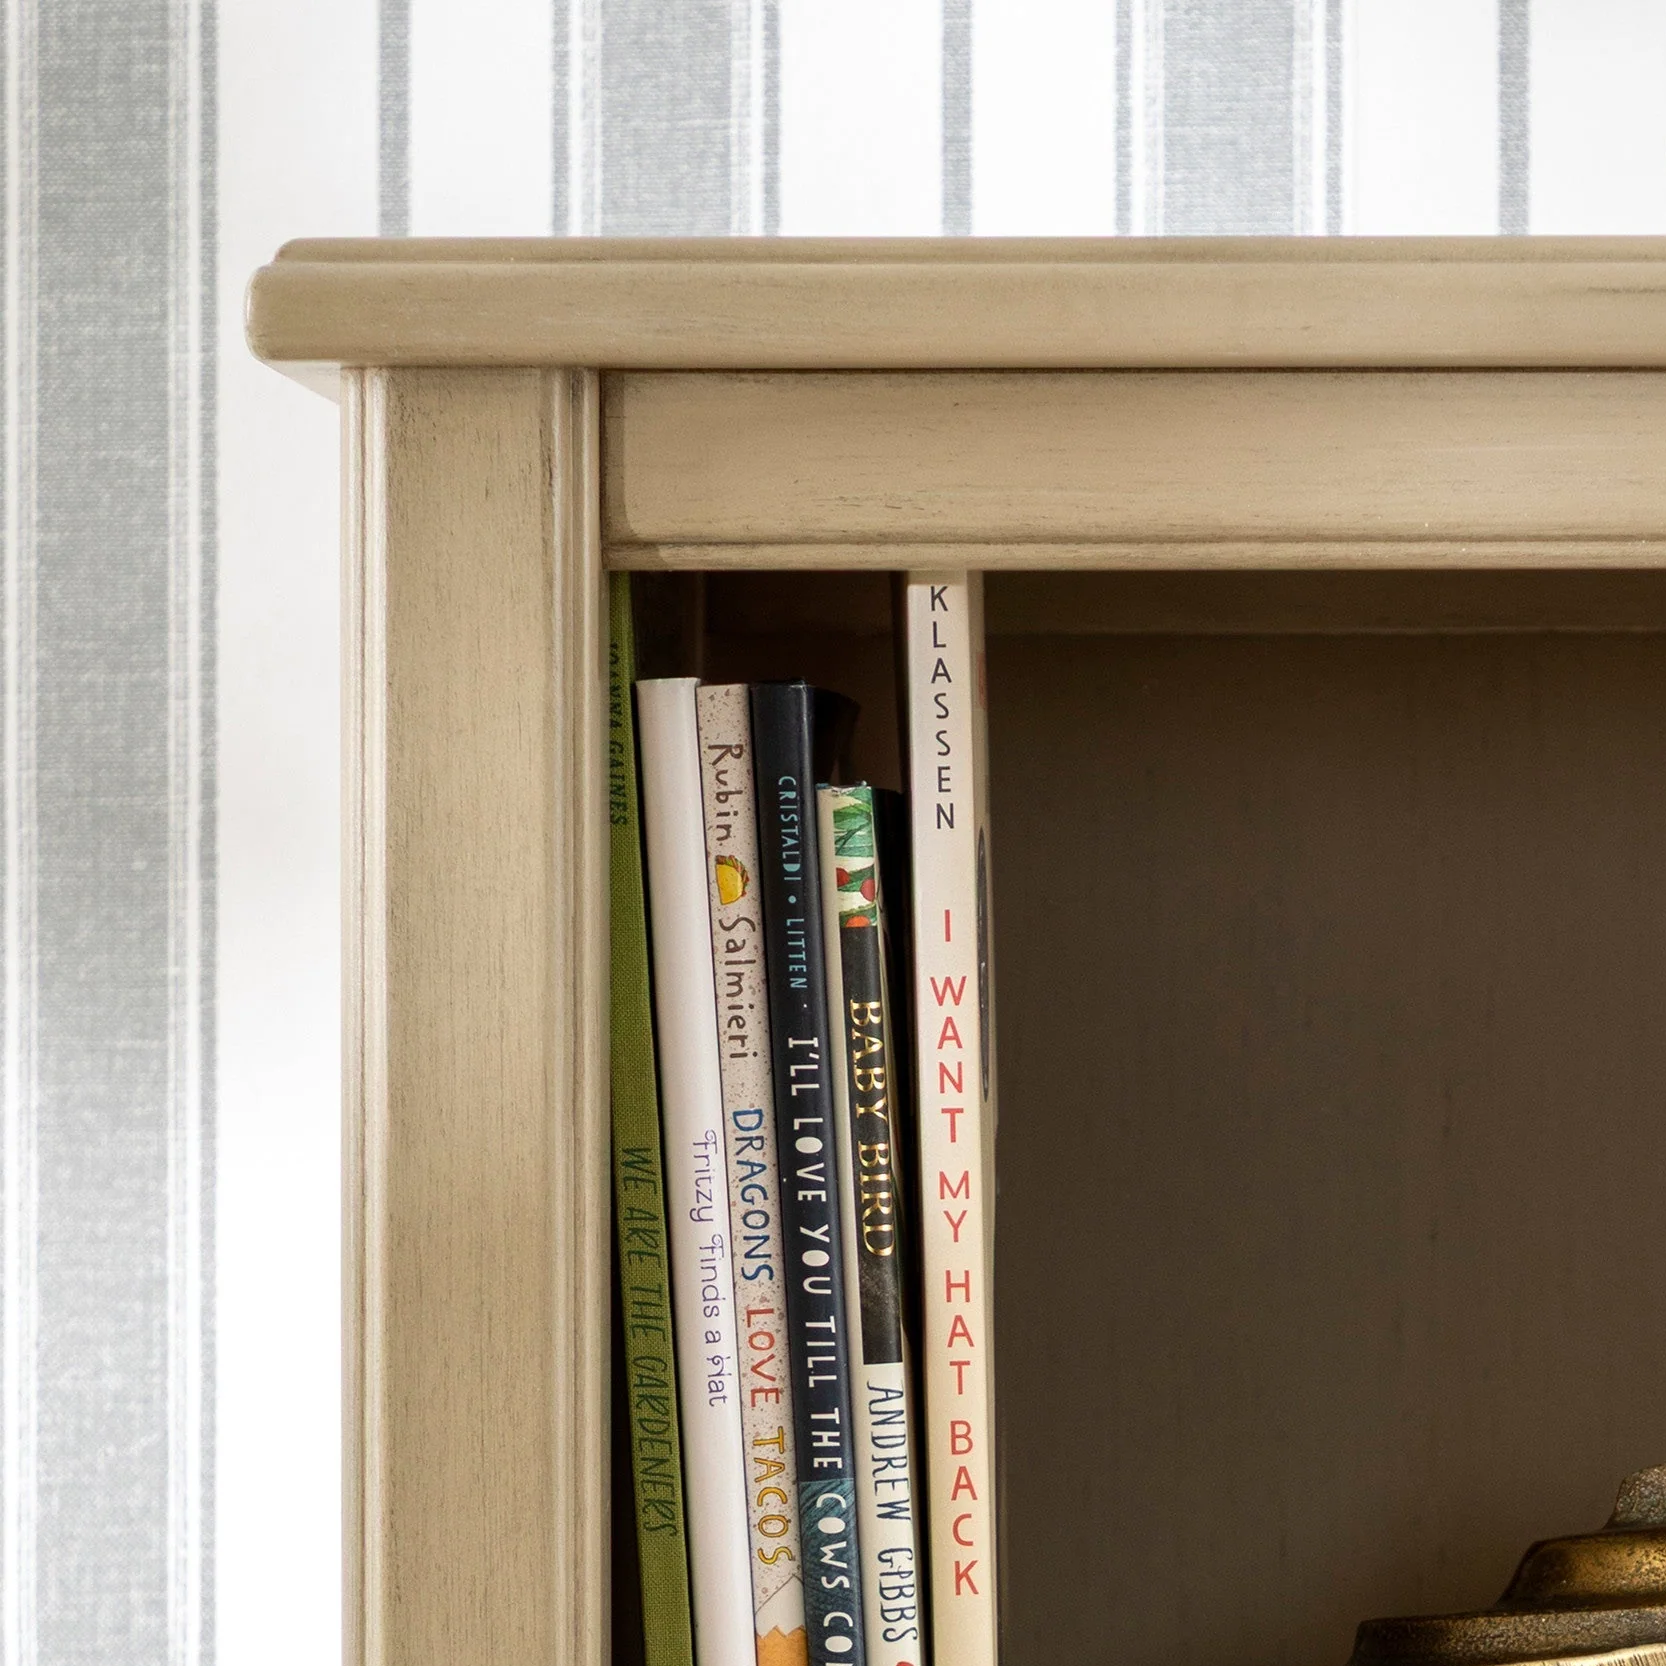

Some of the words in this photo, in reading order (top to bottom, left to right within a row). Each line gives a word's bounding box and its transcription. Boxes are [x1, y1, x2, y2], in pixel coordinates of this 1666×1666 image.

[929, 585, 956, 830] KLASSEN
[707, 742, 744, 843] Rubin
[777, 775, 802, 883] CRISTALDI
[787, 917, 808, 990] LITTEN
[943, 909, 953, 942] I
[718, 917, 758, 1060] Salmieri
[787, 1036, 820, 1098] I'LL
[847, 998, 888, 1123] BABY
[930, 976, 969, 1142] WANT
[622, 1147, 657, 1195] WE
[690, 1129, 719, 1225] Fritzy
[732, 1108, 775, 1283] DRAGONS
[795, 1117, 827, 1203] LOVE
[857, 1140, 895, 1258] BIRD
[937, 1170, 972, 1243] MY
[623, 1206, 662, 1270] ARE
[697, 1234, 724, 1321] Finds
[800, 1223, 832, 1295] YOU
[629, 1284, 667, 1342] THE
[704, 1326, 721, 1345] a
[744, 1307, 780, 1408] LOVE
[804, 1314, 838, 1390] TILL
[943, 1270, 975, 1396] HAT
[632, 1355, 678, 1538] GARDENERS
[810, 1407, 844, 1471] THE
[865, 1379, 913, 1523] ANDREW
[752, 1426, 794, 1566] TACOS
[816, 1491, 850, 1588] COWS
[949, 1420, 980, 1597] BACK
[877, 1545, 919, 1645] GIBBS
